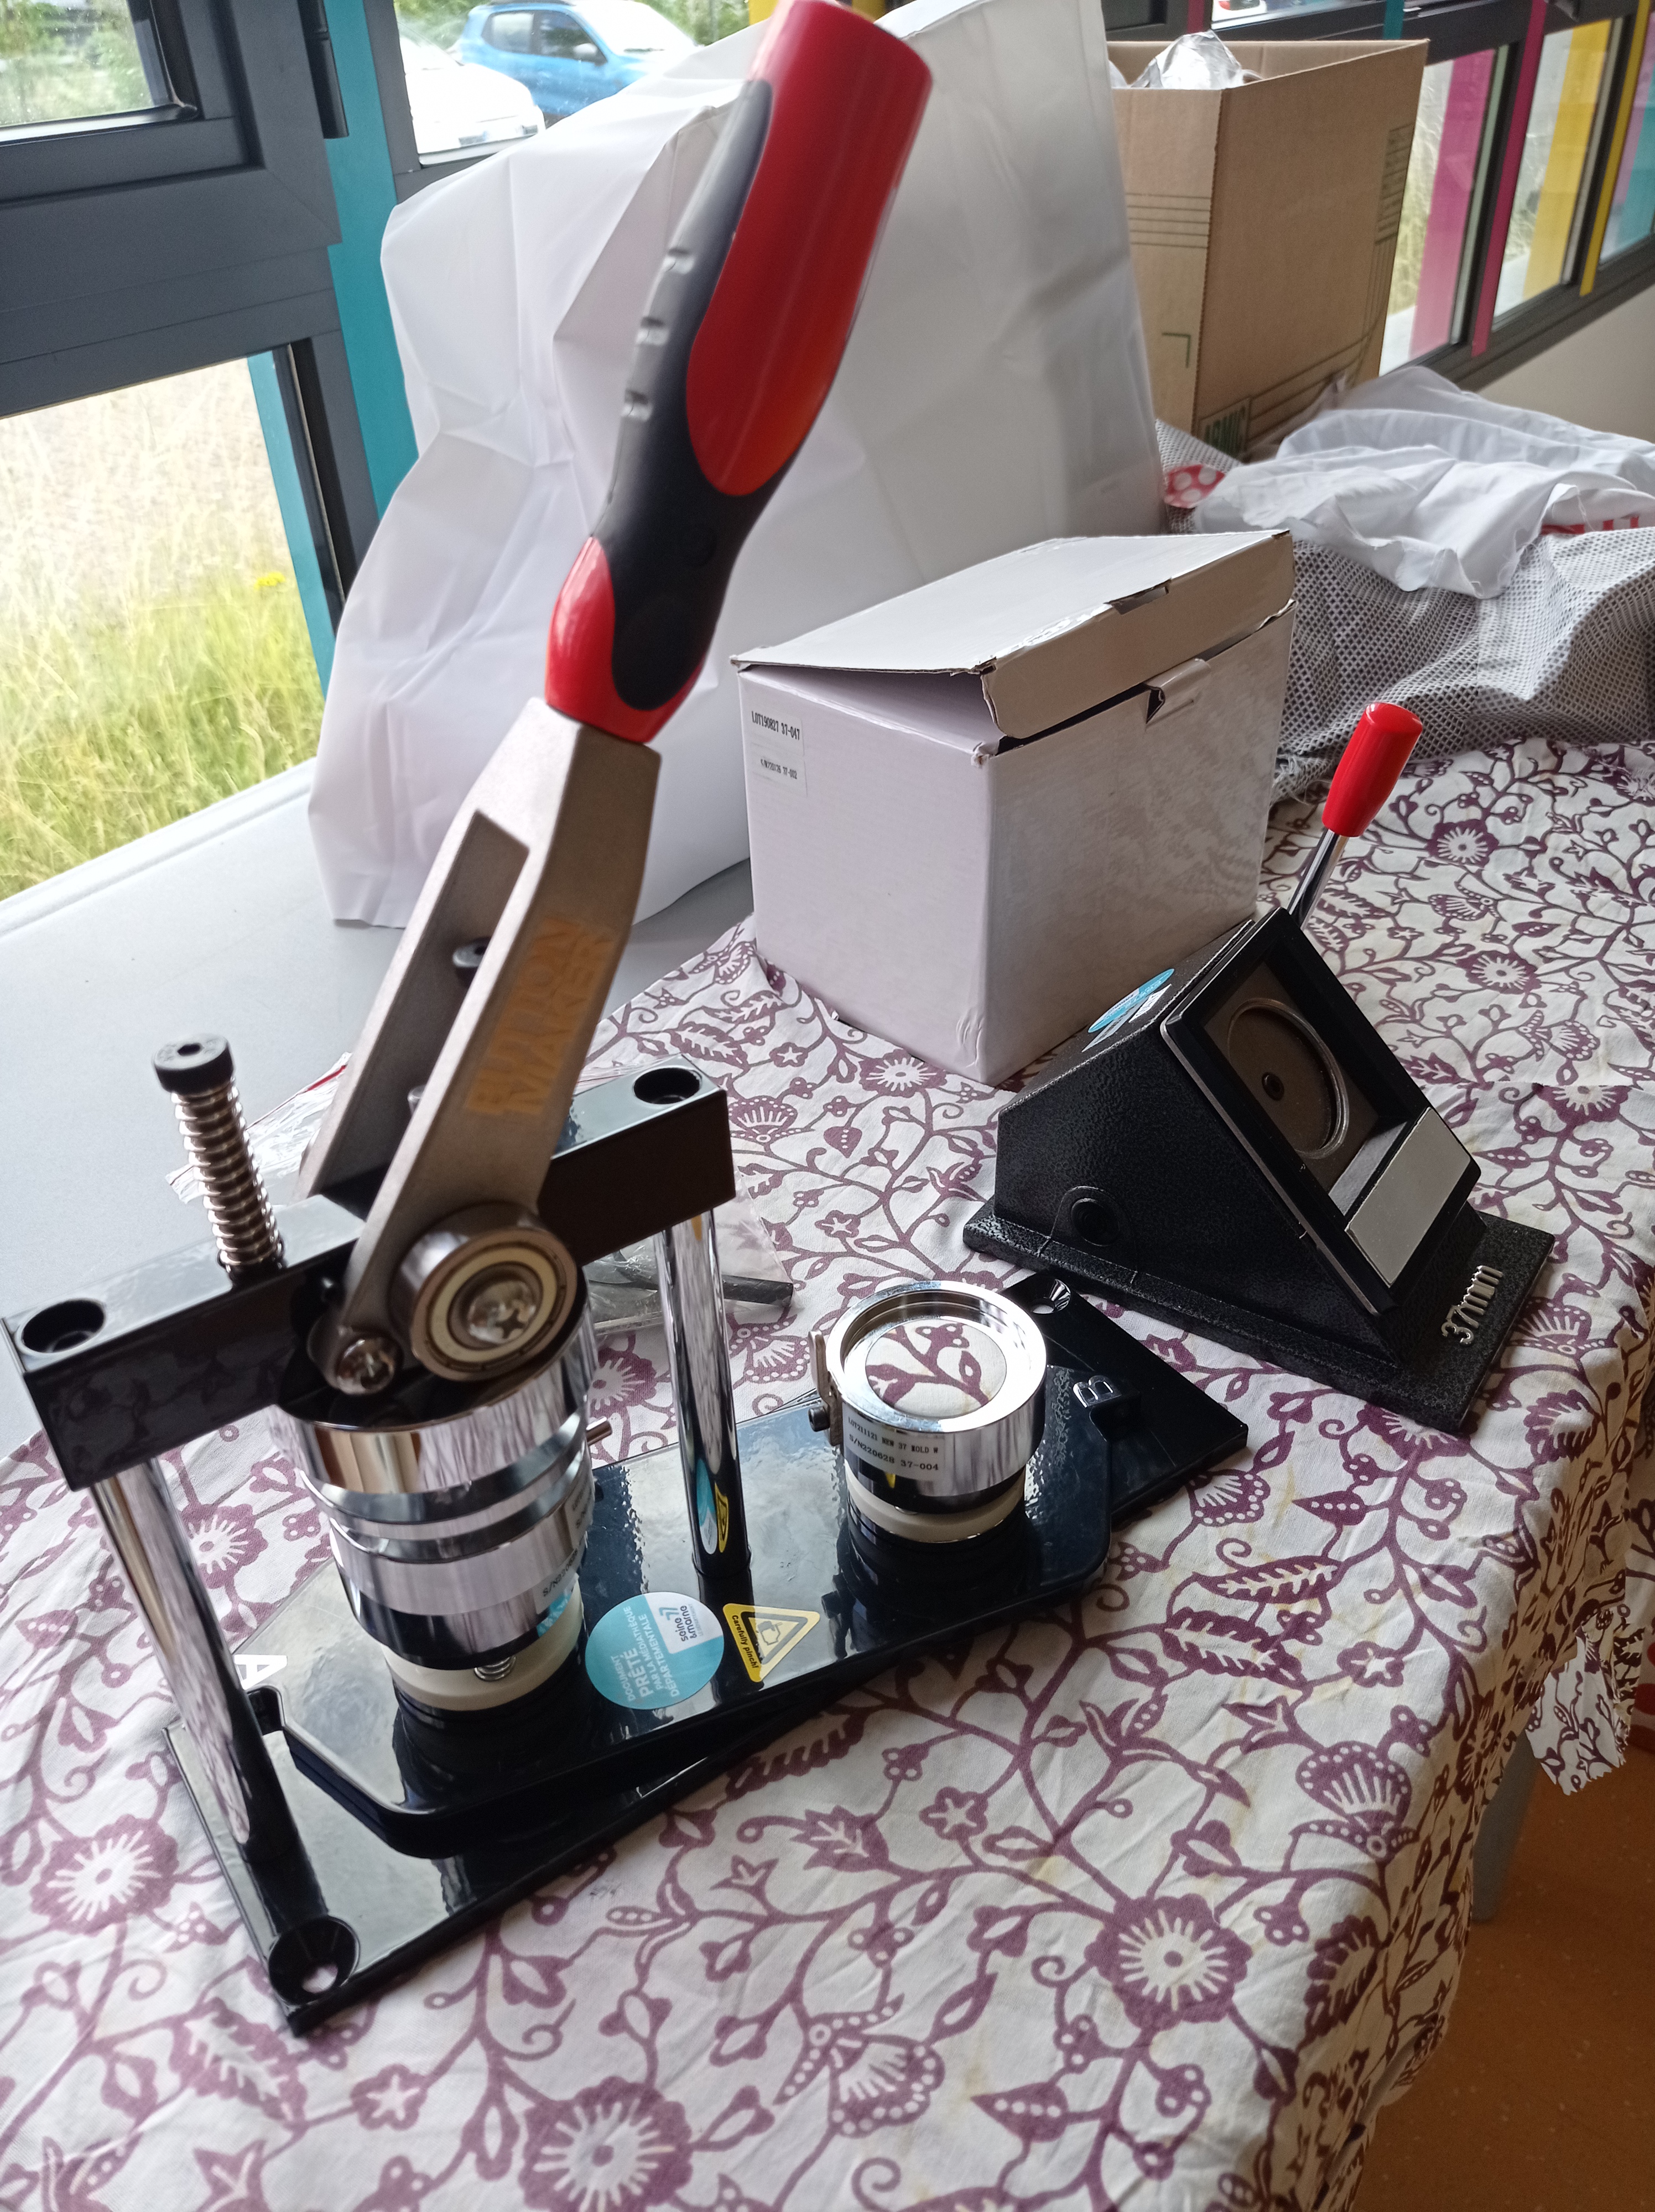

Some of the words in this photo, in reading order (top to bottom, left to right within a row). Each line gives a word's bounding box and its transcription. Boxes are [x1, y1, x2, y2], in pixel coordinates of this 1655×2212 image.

[751, 711, 779, 732] LOT190827
[465, 917, 580, 1114] BUTTON
[507, 930, 615, 1115] MAKER
[1441, 1265, 1503, 1345] 37mm
[1073, 1375, 1122, 1408] B
[848, 1416, 878, 1441] LOT211121
[882, 1437, 894, 1447] NEW
[911, 1445, 929, 1453] MOLD
[849, 1434, 895, 1464] S/N220628
[901, 1460, 939, 1470] 37-004
[623, 1605, 652, 1661] MÉDIATHÈQUE
[674, 1617, 689, 1642] seine
[680, 1605, 698, 1639] &marne
[638, 1614, 680, 1698] DÉPARTEMENTALE
[732, 1615, 748, 1645] Carefully
[743, 1646, 759, 1668] pinch!
[234, 1654, 288, 1691] A
[611, 1655, 636, 1702] DOCUMENT
[620, 1648, 654, 1698] PRÊTÉ
[647, 1660, 657, 1673] LA
[651, 1672, 663, 1691] PAR
